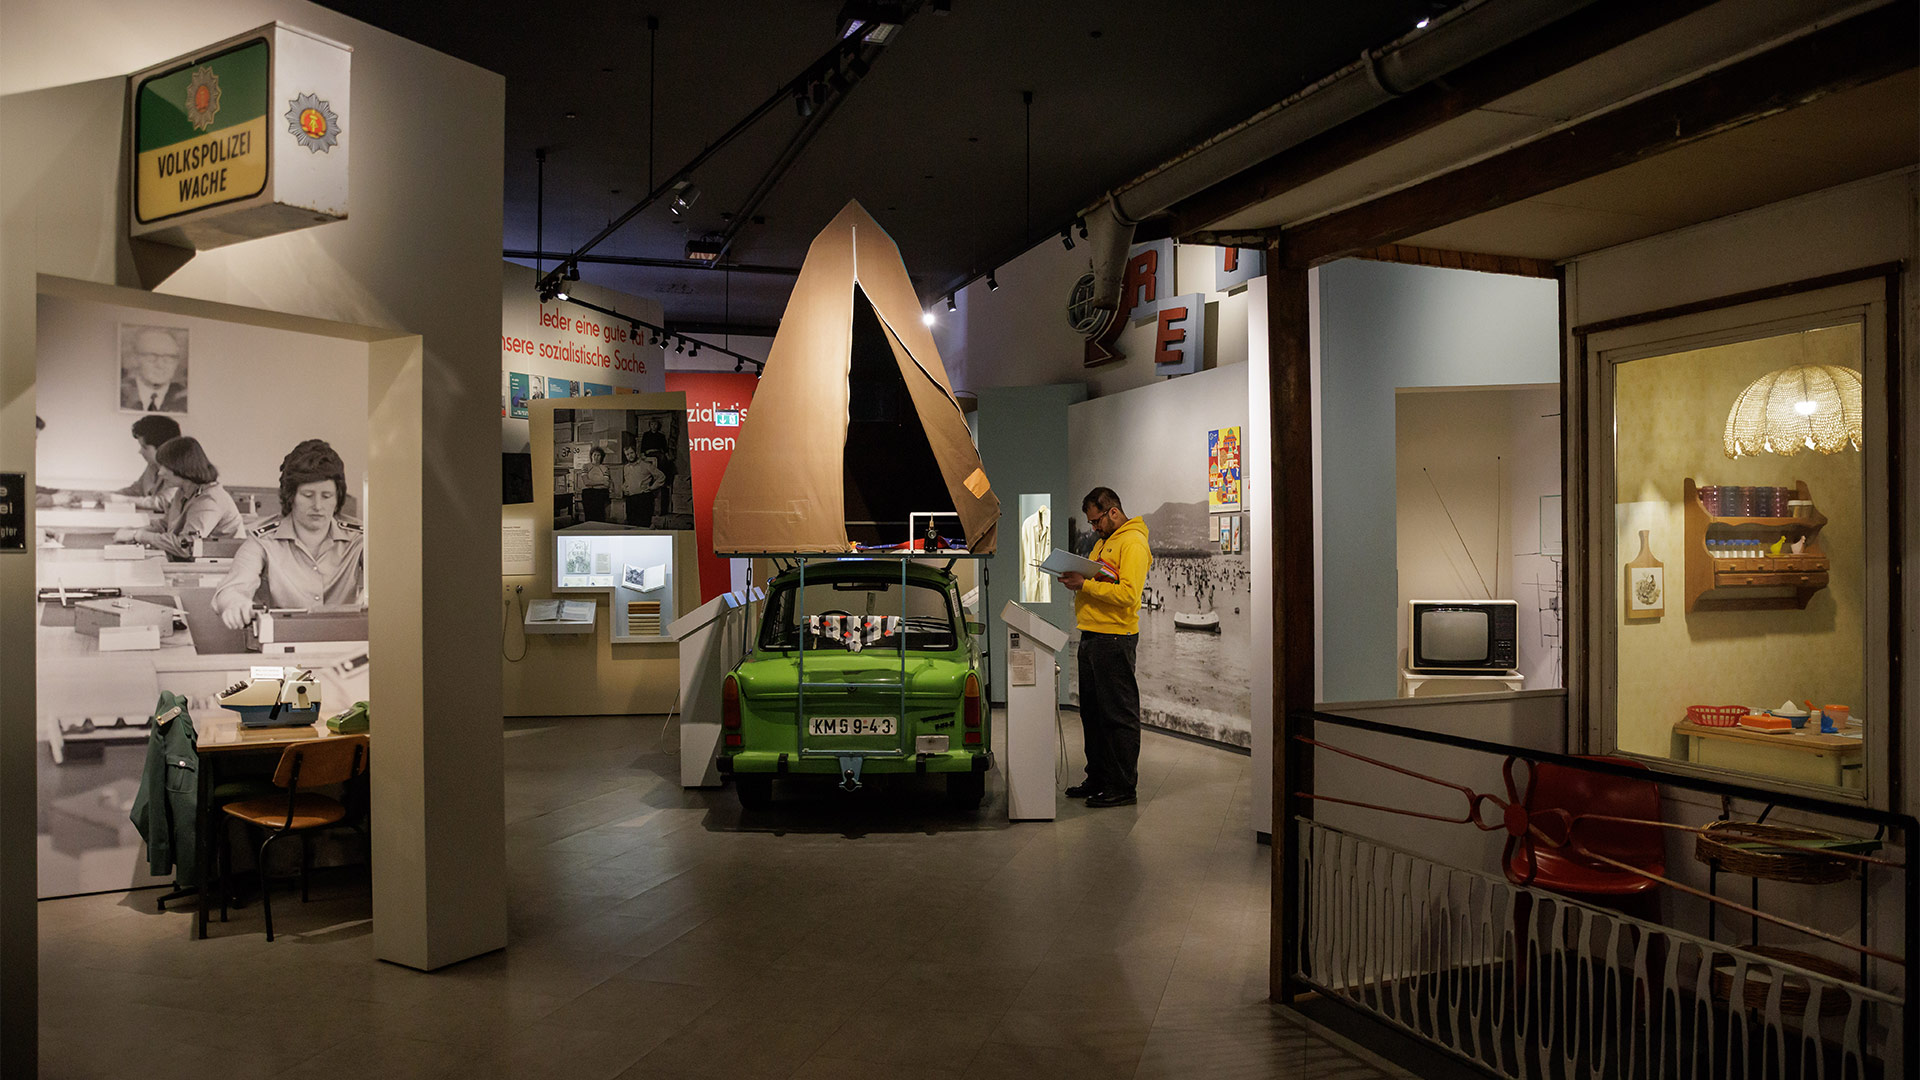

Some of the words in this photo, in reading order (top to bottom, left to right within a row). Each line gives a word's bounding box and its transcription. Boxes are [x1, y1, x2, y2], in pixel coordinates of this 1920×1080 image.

[158, 130, 250, 178] VOLKSPOLIZEI
[179, 168, 228, 202] WACHE
[539, 303, 571, 331] Jeder
[575, 314, 600, 337] eine
[603, 325, 627, 343] gute
[539, 340, 611, 368] sozialistische
[614, 349, 647, 375] Sache.
